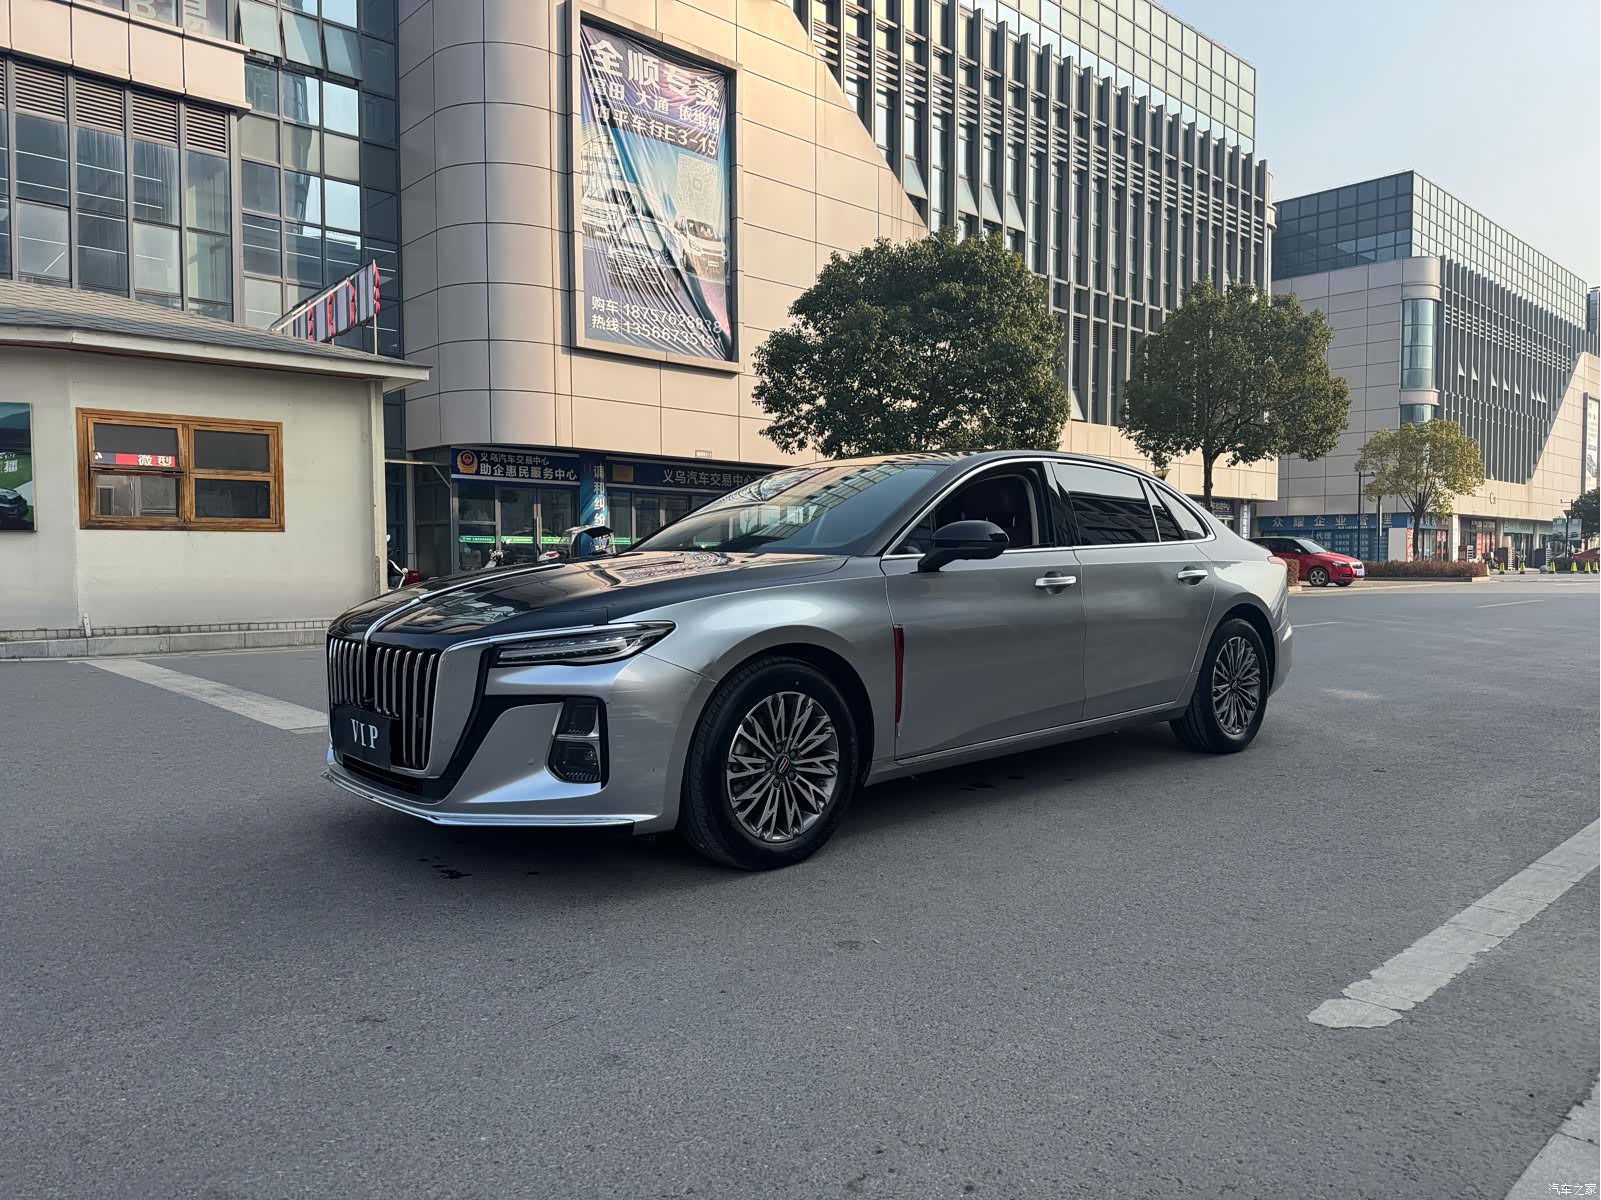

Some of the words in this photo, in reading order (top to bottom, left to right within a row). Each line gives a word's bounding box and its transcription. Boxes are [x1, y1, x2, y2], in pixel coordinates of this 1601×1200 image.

[589, 39, 720, 114] 全顺专卖
[636, 90, 669, 114] 大通
[679, 105, 720, 135] 依维柯
[591, 296, 619, 314] 购车
[591, 314, 620, 332] 热线
[138, 454, 172, 466] 微型
[480, 452, 550, 466] 义乌汽车交易中心
[480, 463, 578, 481] 助企惠民服务中心
[663, 468, 765, 488] 义乌汽车交易中心
[351, 718, 378, 749] VIP
